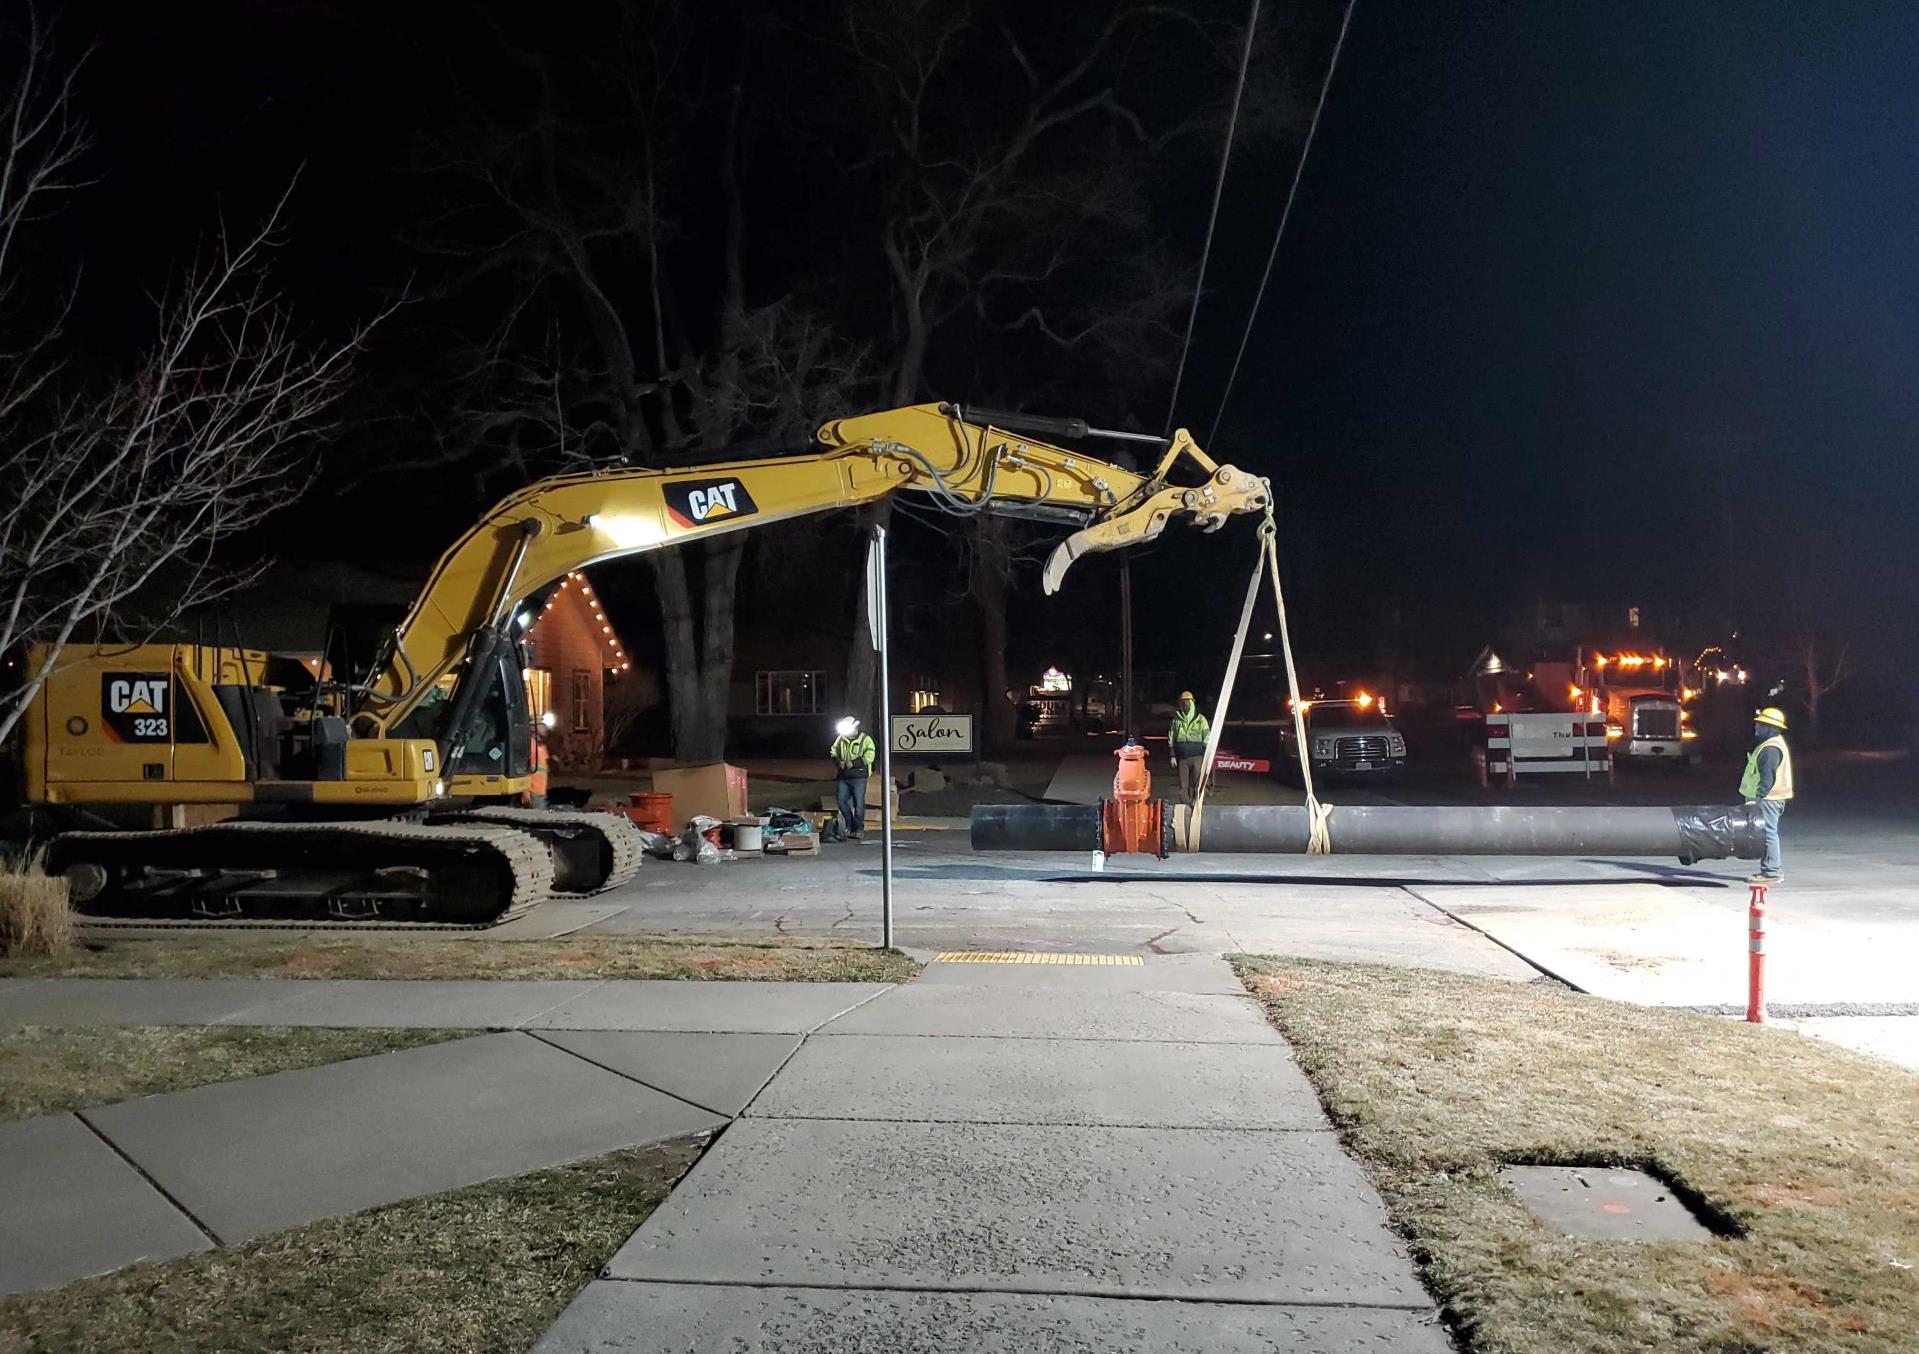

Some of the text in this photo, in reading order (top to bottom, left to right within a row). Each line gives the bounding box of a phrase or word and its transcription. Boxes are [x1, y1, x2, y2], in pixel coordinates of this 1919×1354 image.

[688, 482, 737, 520] CAT
[110, 680, 168, 713] CAT
[134, 719, 168, 736] 323
[898, 717, 965, 750] Salon
[1217, 760, 1256, 771] BEAUTY
